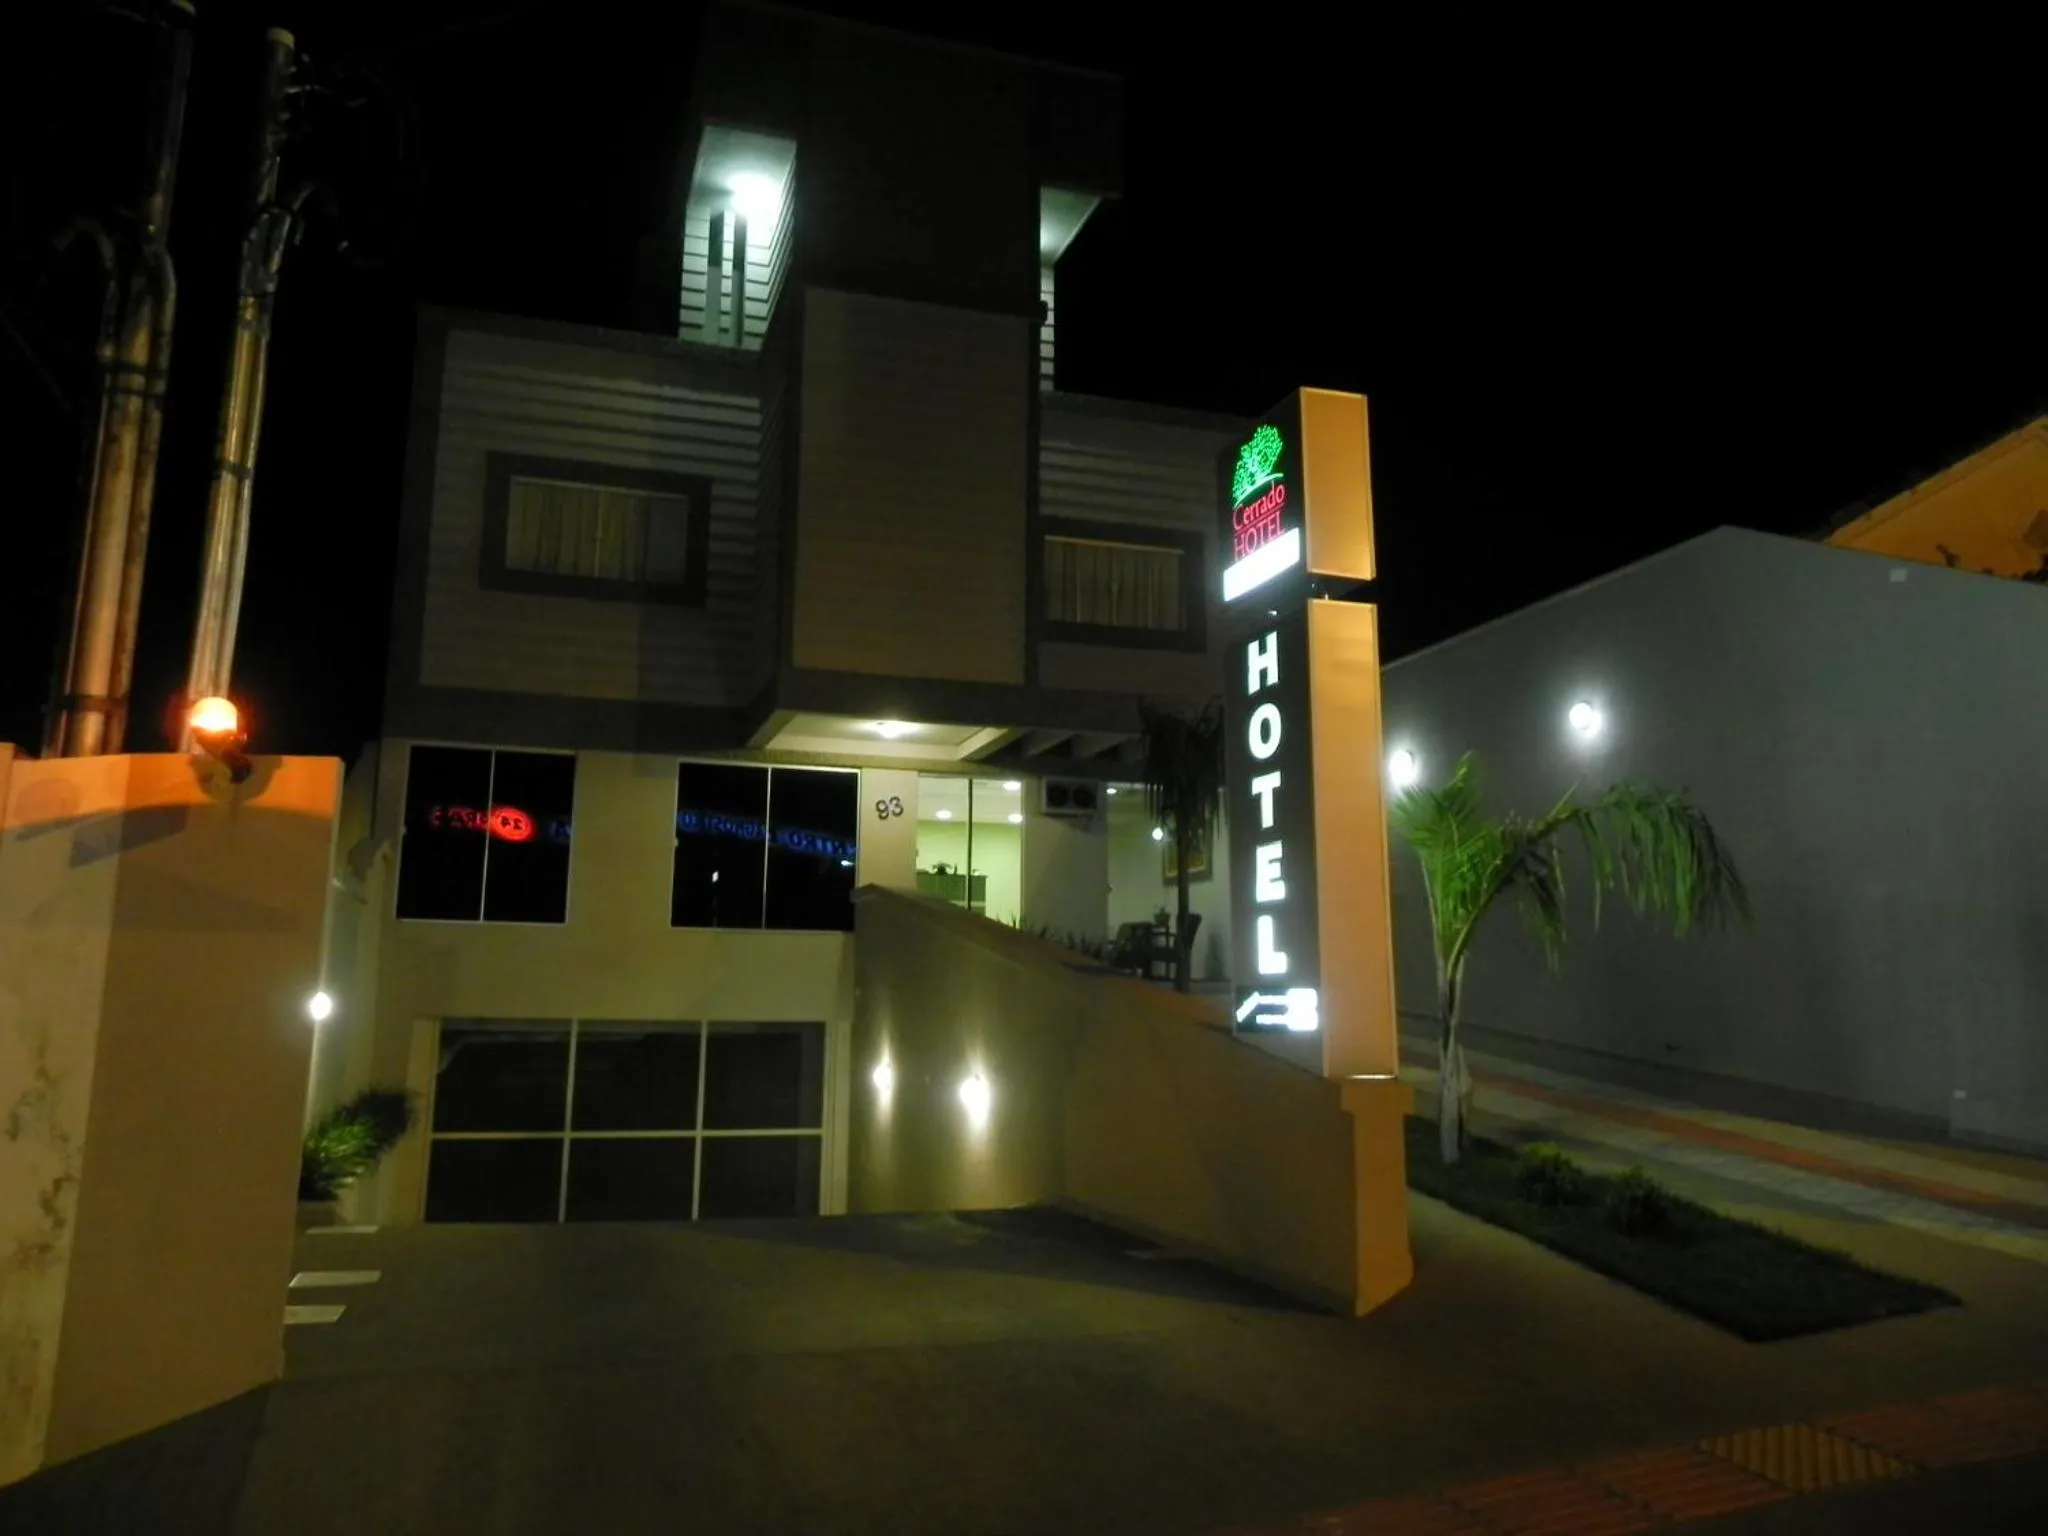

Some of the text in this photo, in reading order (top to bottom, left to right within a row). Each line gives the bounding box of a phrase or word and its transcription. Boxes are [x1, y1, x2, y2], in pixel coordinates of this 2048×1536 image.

[1233, 479, 1285, 531] Cerrado
[1234, 511, 1284, 562] HOTEL
[875, 796, 904, 820] 93
[1247, 631, 1288, 975] HOTEL
